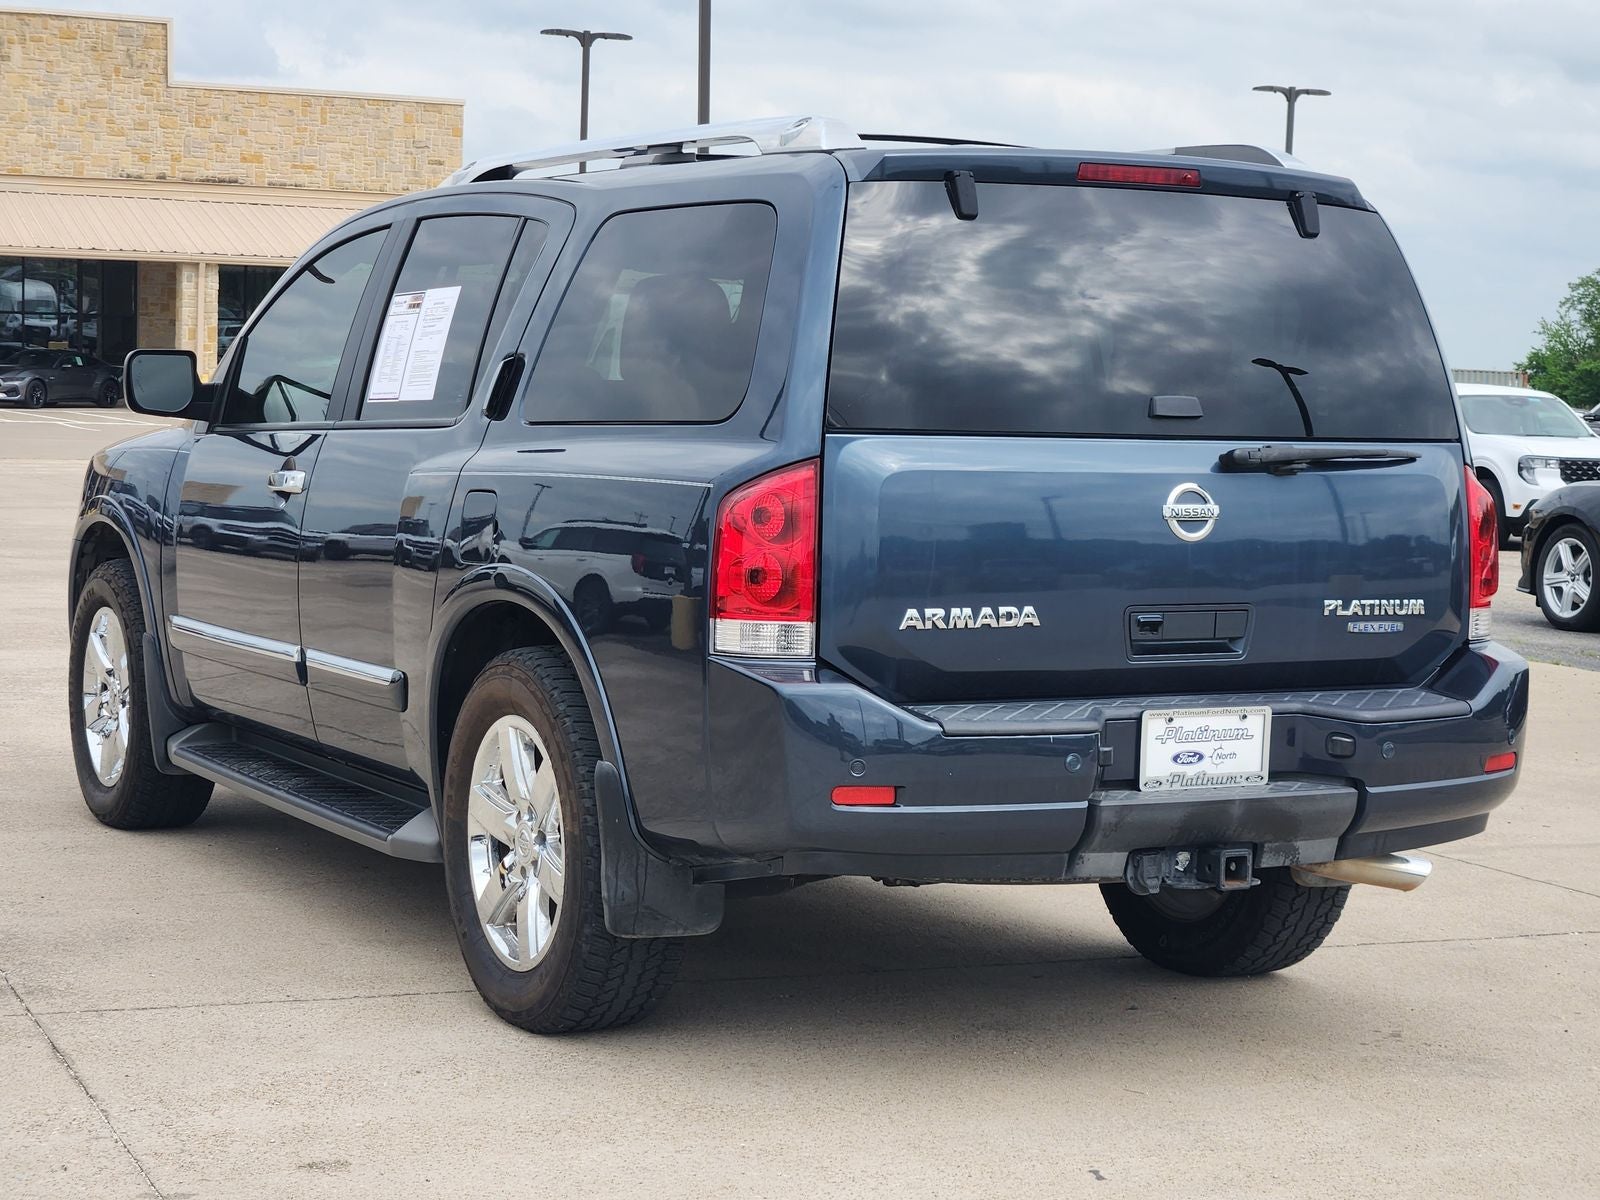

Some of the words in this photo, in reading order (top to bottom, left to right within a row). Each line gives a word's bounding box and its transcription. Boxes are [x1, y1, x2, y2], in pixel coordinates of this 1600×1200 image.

[1171, 508, 1215, 517] NISSAN
[1323, 599, 1425, 616] PLATINUM
[899, 605, 1041, 630] ARMADA
[1352, 623, 1376, 632] FLEX
[1378, 623, 1401, 632] FUEL
[1149, 708, 1266, 717] www.PlatinumFordNorth.com
[1155, 725, 1254, 744] Platinum
[1176, 751, 1200, 764] Ford
[1215, 751, 1237, 760] North
[1168, 770, 1240, 788] Platinum
